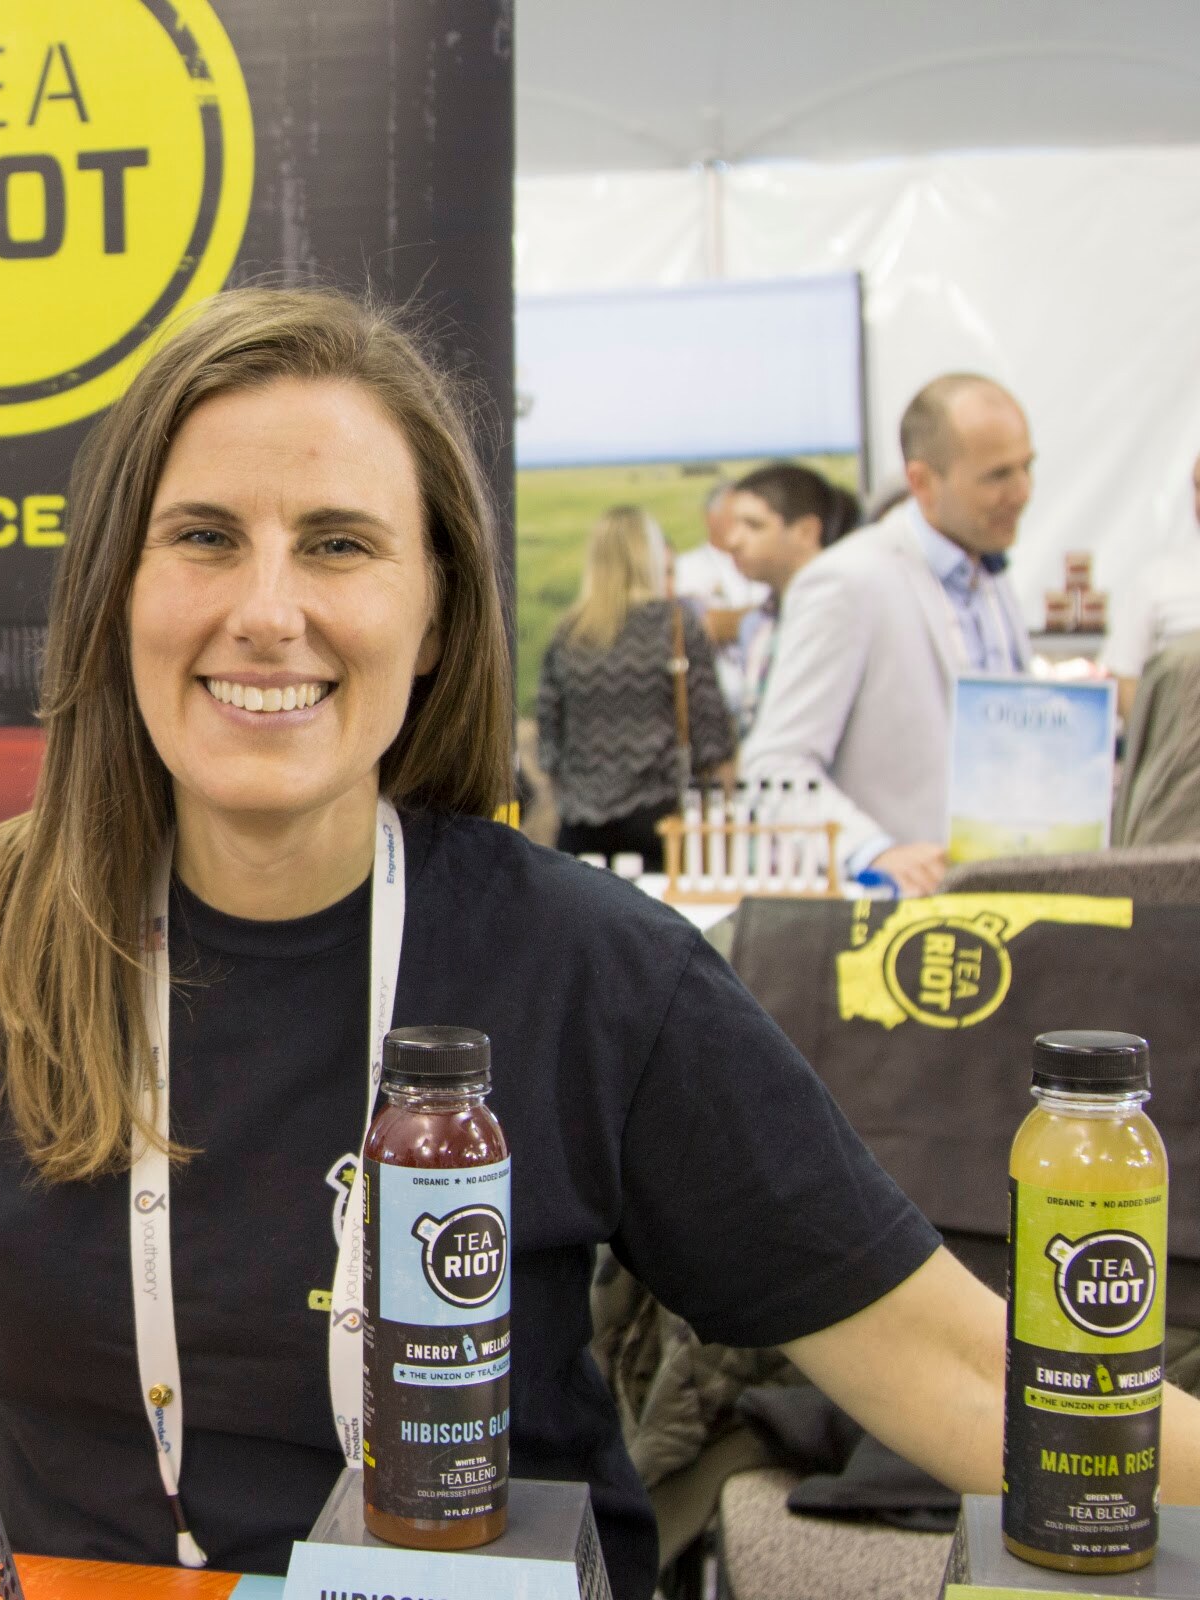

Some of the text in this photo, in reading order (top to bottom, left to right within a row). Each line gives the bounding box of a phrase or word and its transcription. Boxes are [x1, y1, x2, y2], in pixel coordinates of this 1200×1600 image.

[386, 832, 396, 884] Engredea
[919, 932, 956, 1011] RIOT
[955, 946, 982, 999] TEA
[413, 1177, 449, 1186] ORGANIC
[1047, 1196, 1085, 1208] ORGANIC
[1118, 1199, 1143, 1208] ADDED
[453, 1231, 492, 1252] TEA
[142, 1219, 158, 1296] youtheory
[346, 1225, 361, 1300] youtheory
[444, 1249, 500, 1278] RIOT
[1087, 1258, 1134, 1278] TEA
[1076, 1279, 1145, 1304] RIOT
[406, 1343, 458, 1360] ENERGY
[409, 1371, 427, 1380] THE
[430, 1372, 461, 1380] UNION
[464, 1371, 475, 1379] OF
[478, 1368, 495, 1376] TEA
[1036, 1365, 1161, 1389] ENERGY WELLNESS
[1040, 1397, 1057, 1407] THE
[1061, 1400, 1095, 1410] UNION
[1098, 1402, 1111, 1410] OF
[1114, 1402, 1134, 1410] TEA
[352, 1418, 360, 1460] Products
[401, 1420, 483, 1444] HIBISCUS
[455, 1456, 487, 1467] WHITE TEA
[1041, 1447, 1155, 1477] MATCHA RISE
[439, 1466, 497, 1485] TEA BLEND
[417, 1490, 435, 1498] COLD
[436, 1490, 467, 1498] PRESSED
[1085, 1493, 1110, 1501] GREEN
[1068, 1505, 1136, 1520] TEA BLEND
[1044, 1520, 1063, 1530] COLD
[1065, 1523, 1098, 1533] PRESSED
[1100, 1524, 1123, 1533] FRUITS
